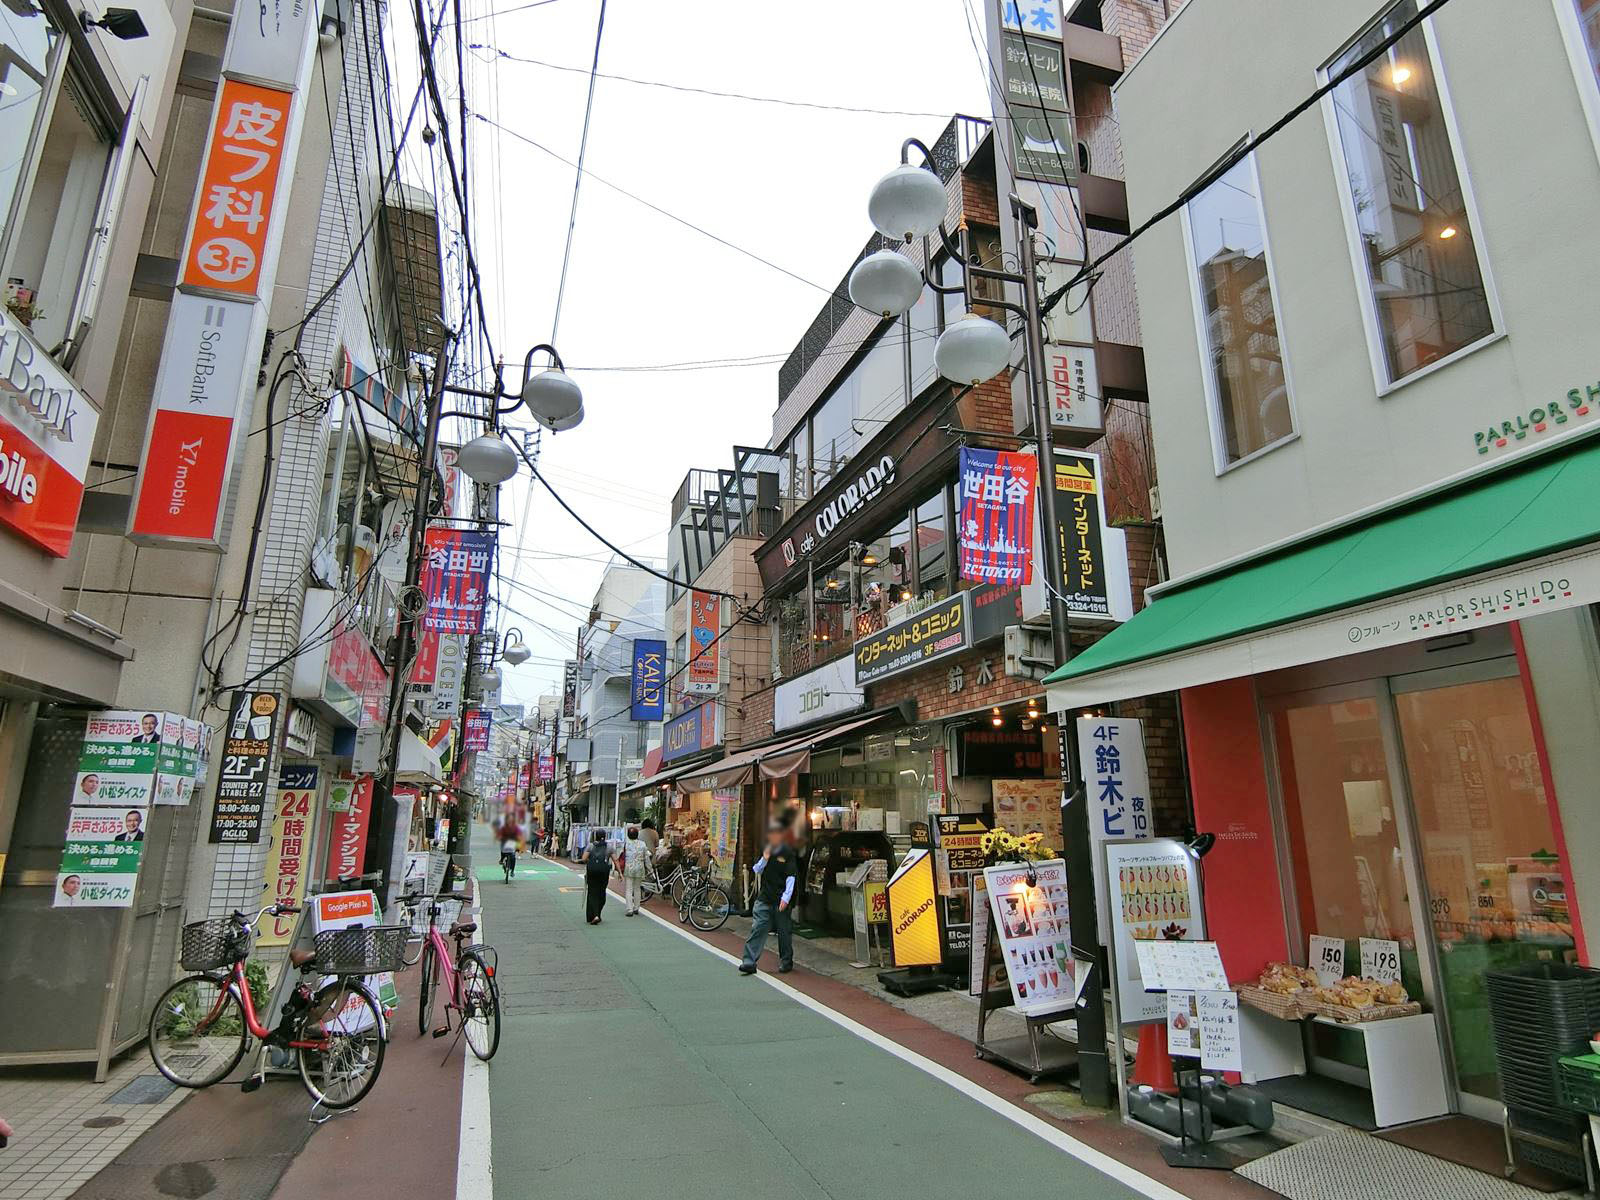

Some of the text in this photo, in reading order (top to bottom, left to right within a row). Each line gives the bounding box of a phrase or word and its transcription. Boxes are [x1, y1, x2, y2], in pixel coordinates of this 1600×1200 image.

[1006, 46, 1059, 73] 鈴木ビル
[1008, 78, 1063, 102] 歯科医院
[204, 101, 282, 235] 皮フ科
[203, 244, 249, 277] 3F
[189, 330, 221, 405] SoftBank
[0, 330, 77, 443] Bank
[1052, 355, 1071, 410] コロラド
[1055, 412, 1075, 422] 2F
[1474, 401, 1564, 446] PARLOR
[967, 457, 993, 469] Welcome
[1013, 465, 1026, 474] city
[963, 468, 1029, 505] 世田谷
[815, 455, 896, 539] COLORADO
[976, 502, 1007, 512] SETAGAYA
[1073, 494, 1094, 590] インターネット
[1363, 619, 1401, 638] フルーツ
[1409, 604, 1465, 625] PARLOR
[1470, 579, 1570, 612] SHISHIDO
[857, 604, 961, 665] インターネット&コミック
[642, 653, 661, 706] KALDI
[437, 701, 453, 710] 2F
[88, 722, 140, 735] 宍戸さぶろう
[1093, 726, 1120, 741] 4F
[668, 723, 685, 752] KALDI
[86, 744, 155, 757] 決める。進める。
[223, 755, 249, 774] 2F
[98, 786, 148, 799] 小松ダイスケ
[221, 781, 264, 793] COUNTER 27
[218, 804, 261, 812] 18:00-26:00
[71, 820, 124, 834] 宍戸さぶろう
[216, 819, 258, 828] 17:00-25:00
[941, 821, 957, 833] 3F
[222, 829, 248, 837] AGLIO
[68, 844, 139, 855] 決める。進める。
[951, 859, 985, 869] &コミック
[80, 887, 131, 900] 小松ダイスケ
[327, 900, 368, 914] Google Pixel 3a
[895, 898, 934, 935] COLORADO
[1321, 947, 1341, 963] 150
[1373, 951, 1398, 970] 198
